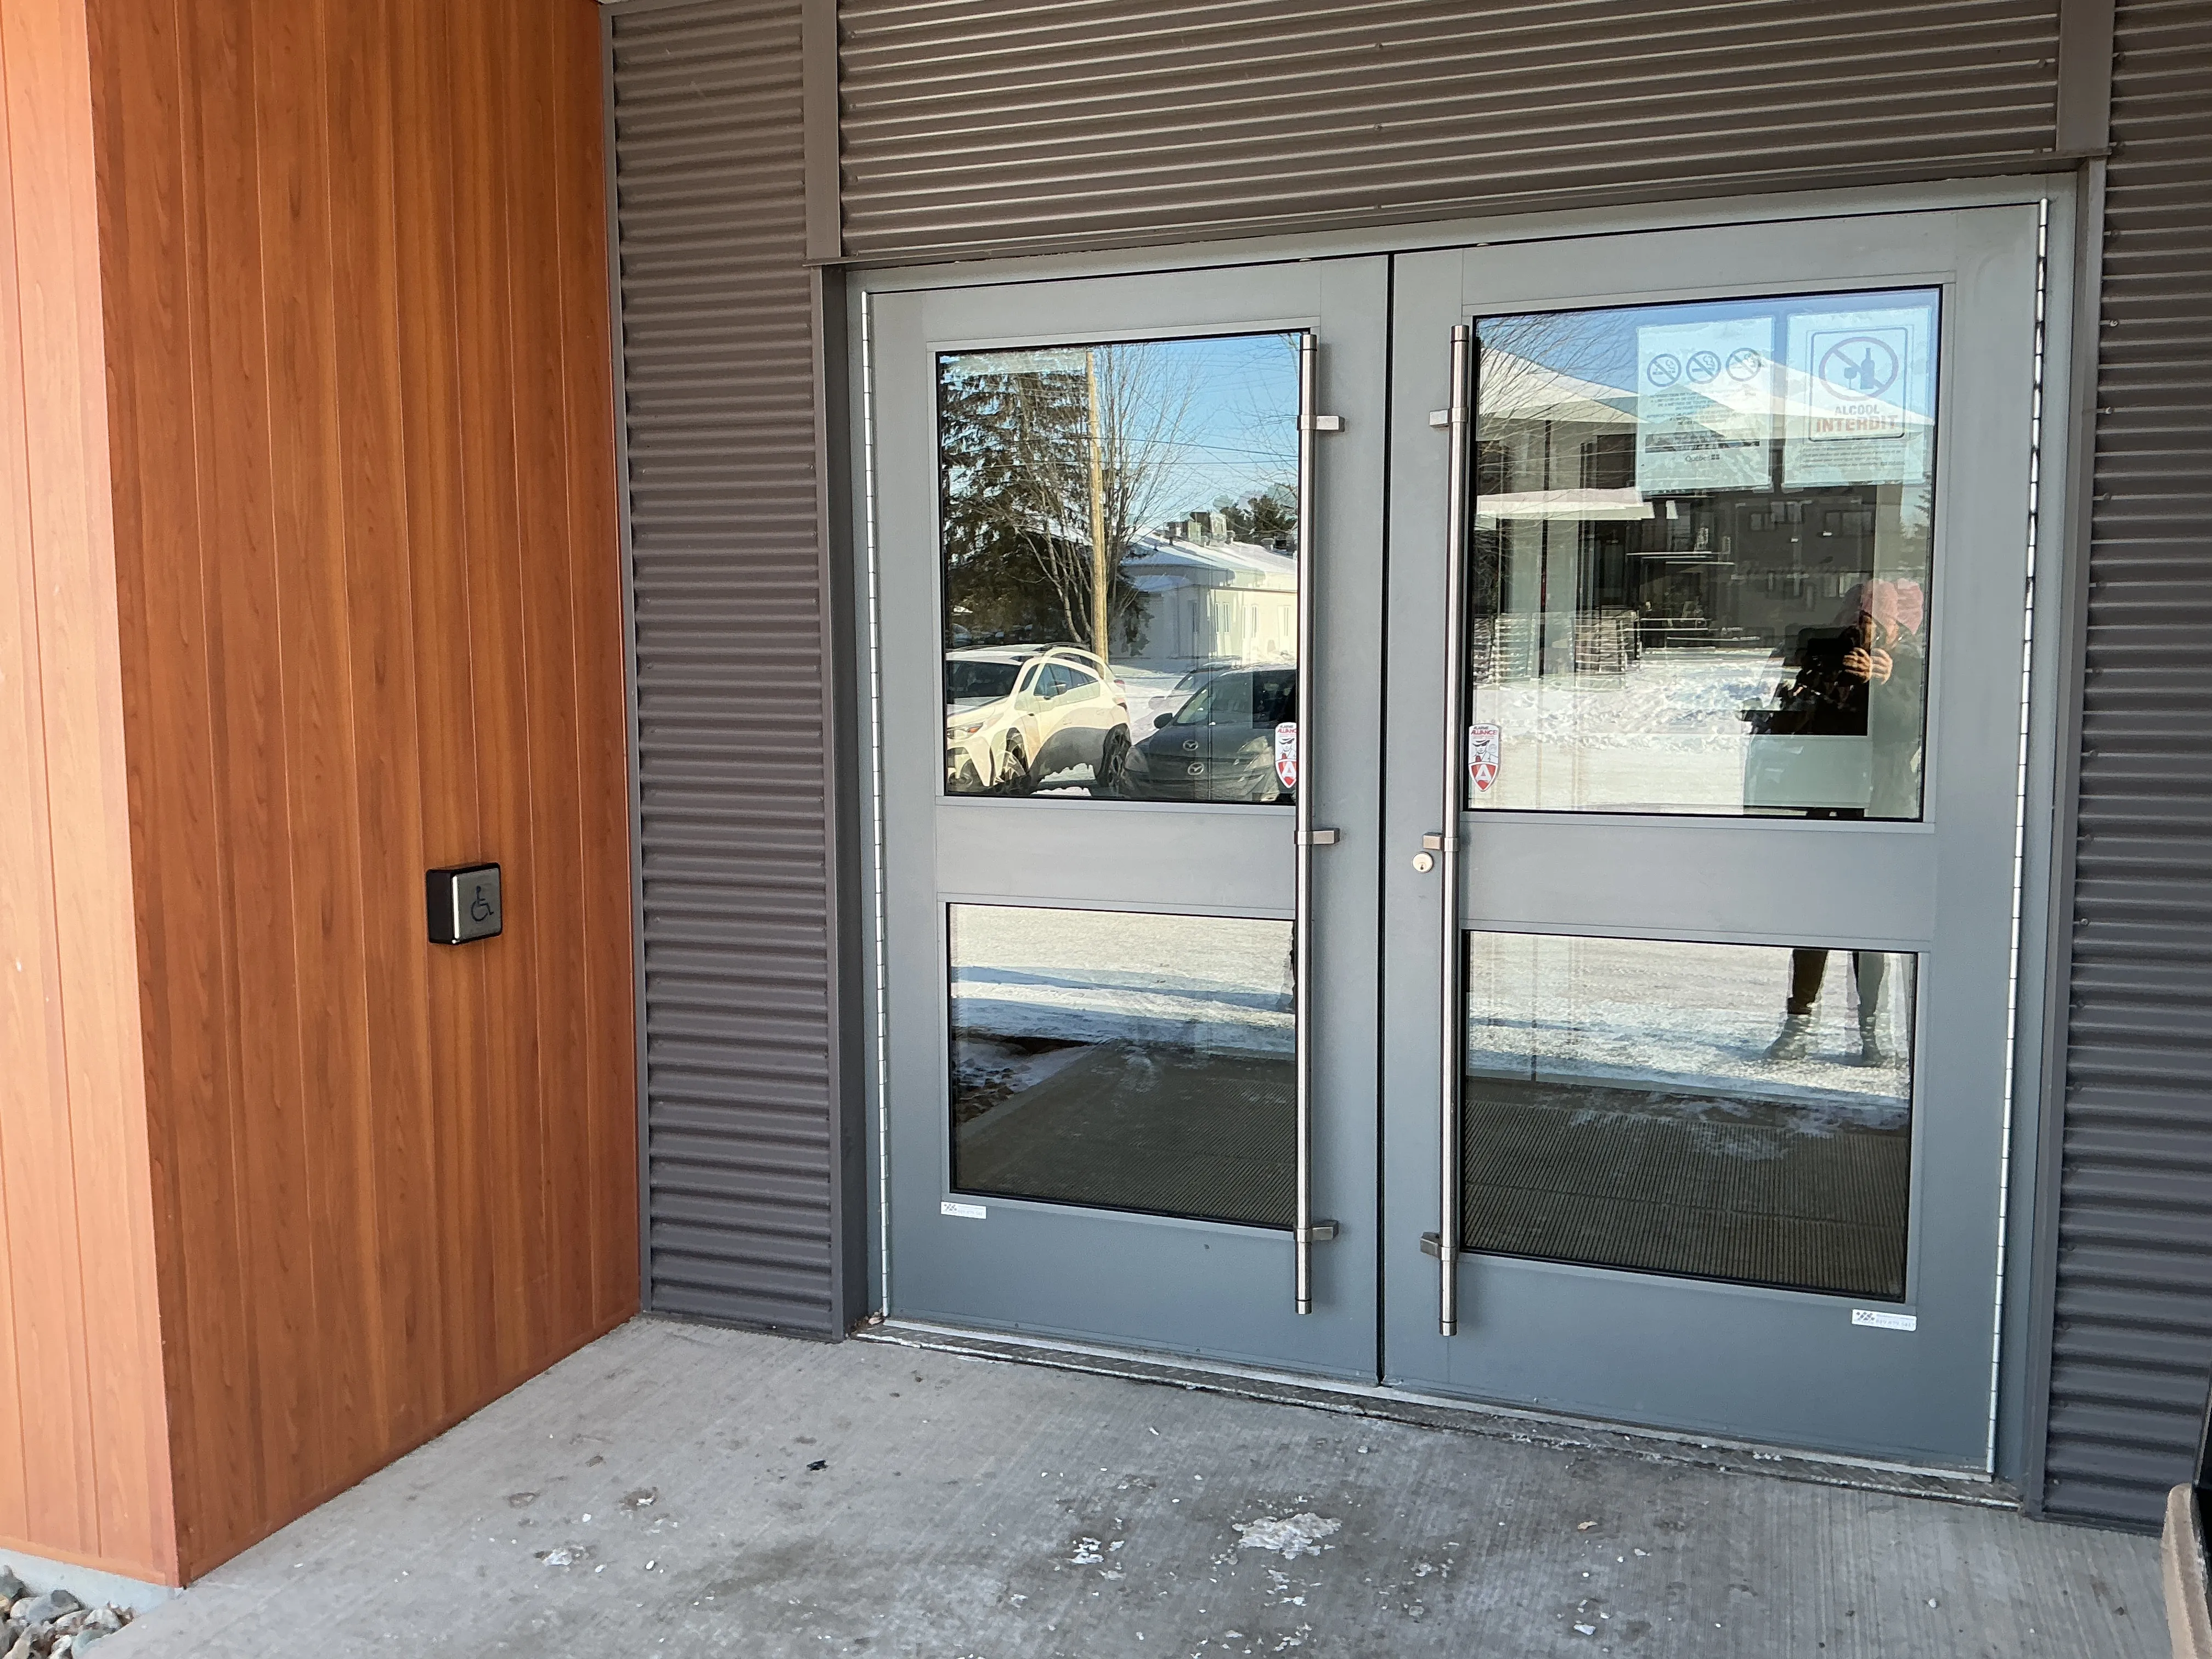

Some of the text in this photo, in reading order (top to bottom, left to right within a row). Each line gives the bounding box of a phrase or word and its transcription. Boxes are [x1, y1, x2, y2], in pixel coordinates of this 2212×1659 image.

[1835, 404, 1880, 416] ALCOOL
[1816, 415, 1898, 433] INTERDIT
[1282, 761, 1296, 779] A
[1475, 764, 1492, 782] A
